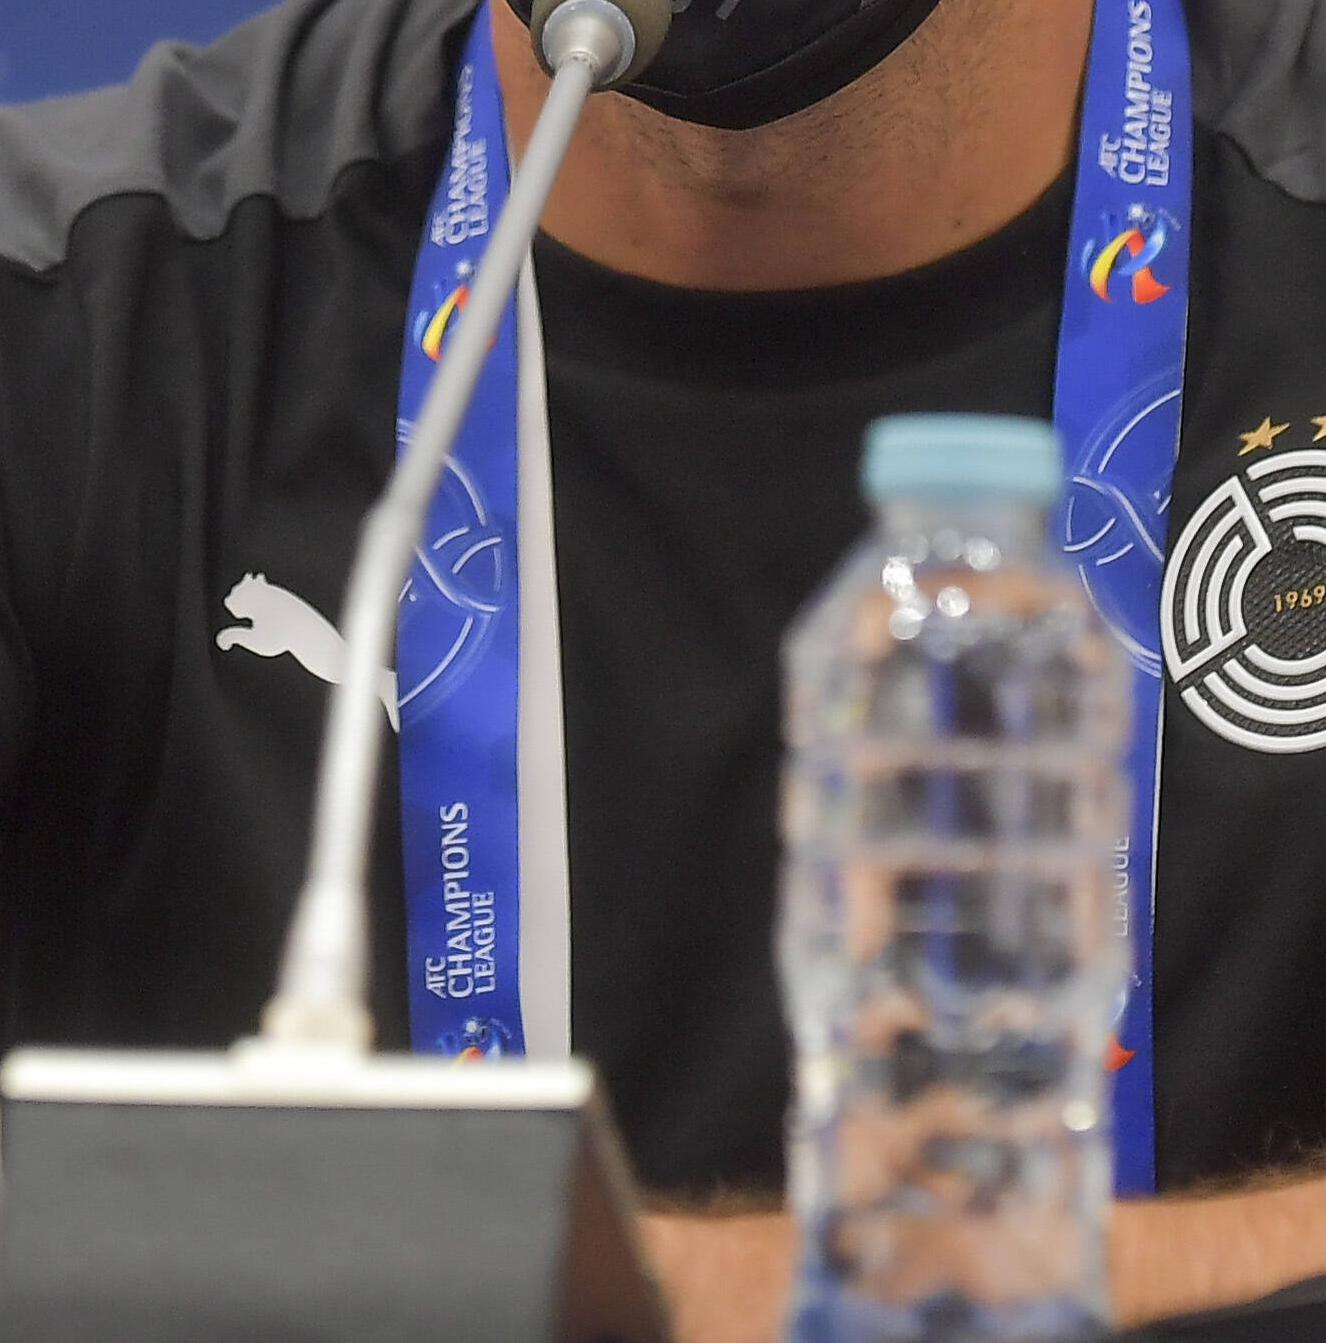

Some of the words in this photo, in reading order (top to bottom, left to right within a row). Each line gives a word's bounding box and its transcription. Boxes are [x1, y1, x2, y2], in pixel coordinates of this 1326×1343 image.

[1147, 89, 1173, 186] LEAGUE
[1274, 585, 1326, 613] 1969
[440, 802, 474, 998] CHAMPIONS
[472, 892, 496, 994] LEAGUE
[425, 957, 446, 999] AFC
